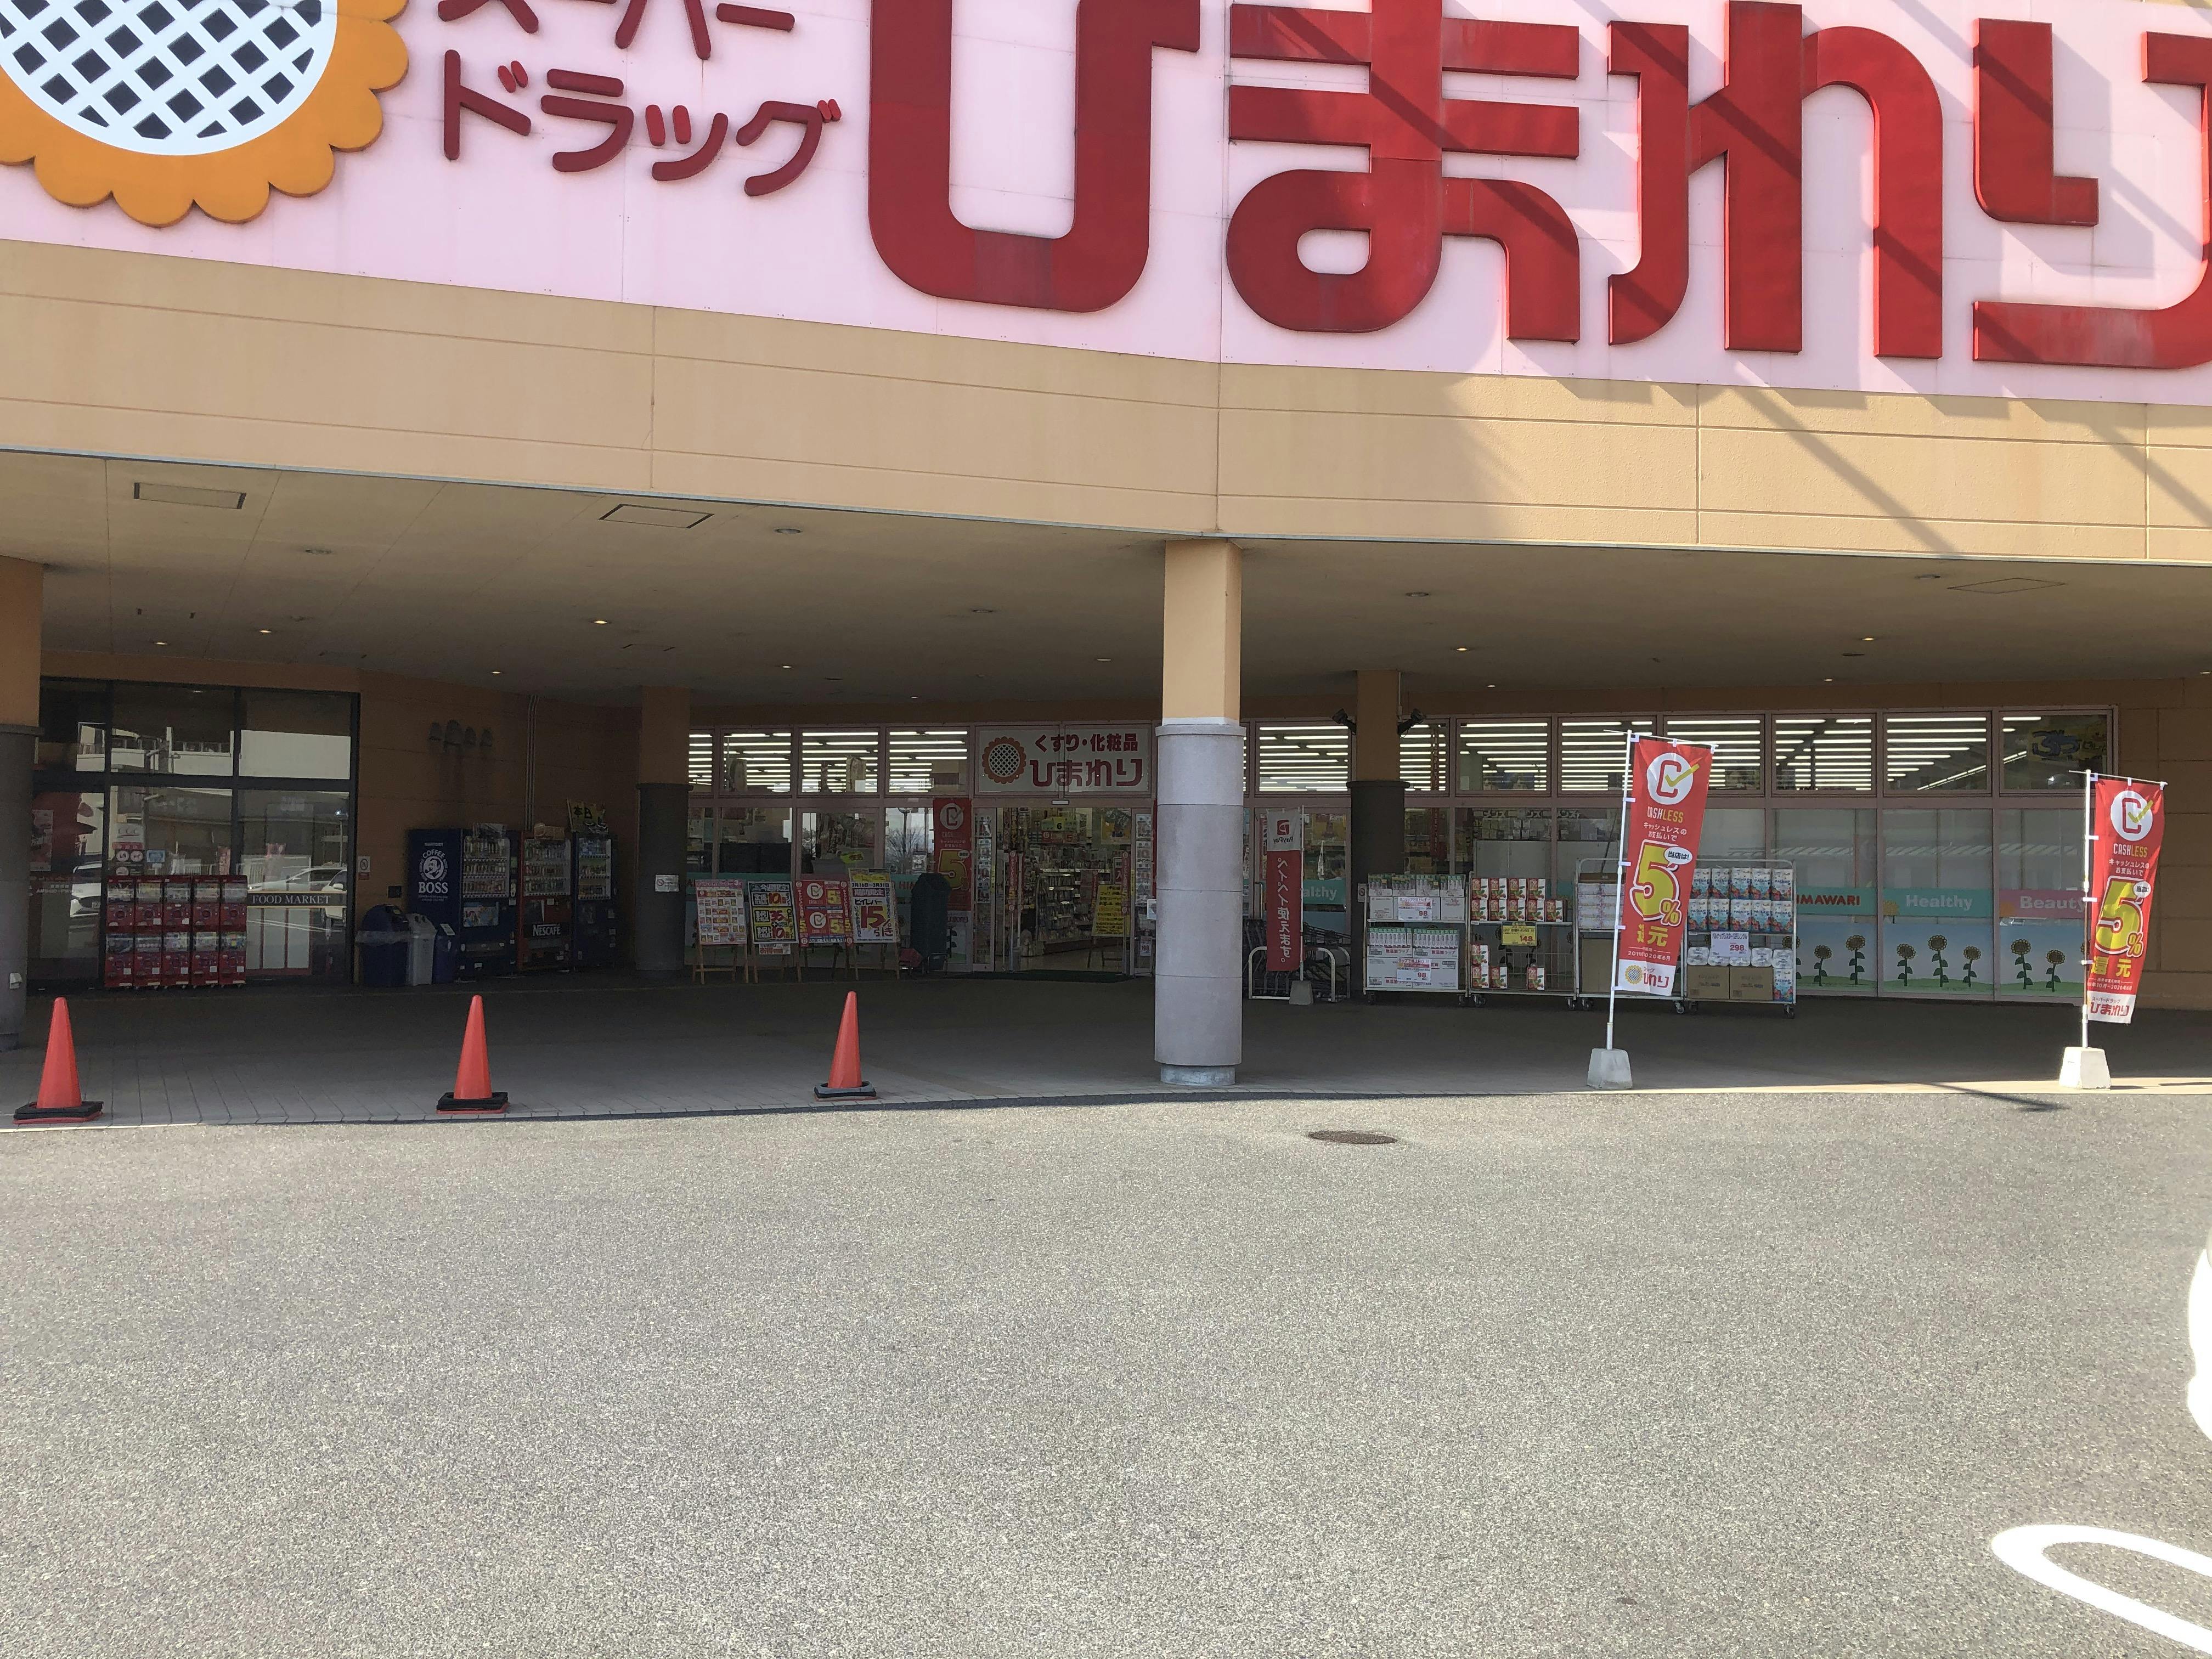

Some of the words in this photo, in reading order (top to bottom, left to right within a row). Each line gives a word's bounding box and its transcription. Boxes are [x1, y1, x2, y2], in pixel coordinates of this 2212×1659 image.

[443, 49, 842, 196] ドラッグ
[1035, 733, 1138, 752] くすり・化粧品
[1029, 759, 1142, 786] ひまわり
[422, 849, 445, 859] COFFEE
[2113, 843, 2148, 857] CASHLESS
[2108, 859, 2149, 869] キャッシュレスの
[418, 881, 448, 894] BOSS
[1302, 886, 1338, 901] althy
[252, 895, 282, 904] FOOD
[285, 895, 330, 904] MARKET
[1797, 894, 1860, 906] IMAWARI
[1905, 895, 1973, 911] Healthy
[2020, 895, 2085, 912] Beauty
[2090, 1002, 2131, 1017] ひまわり
